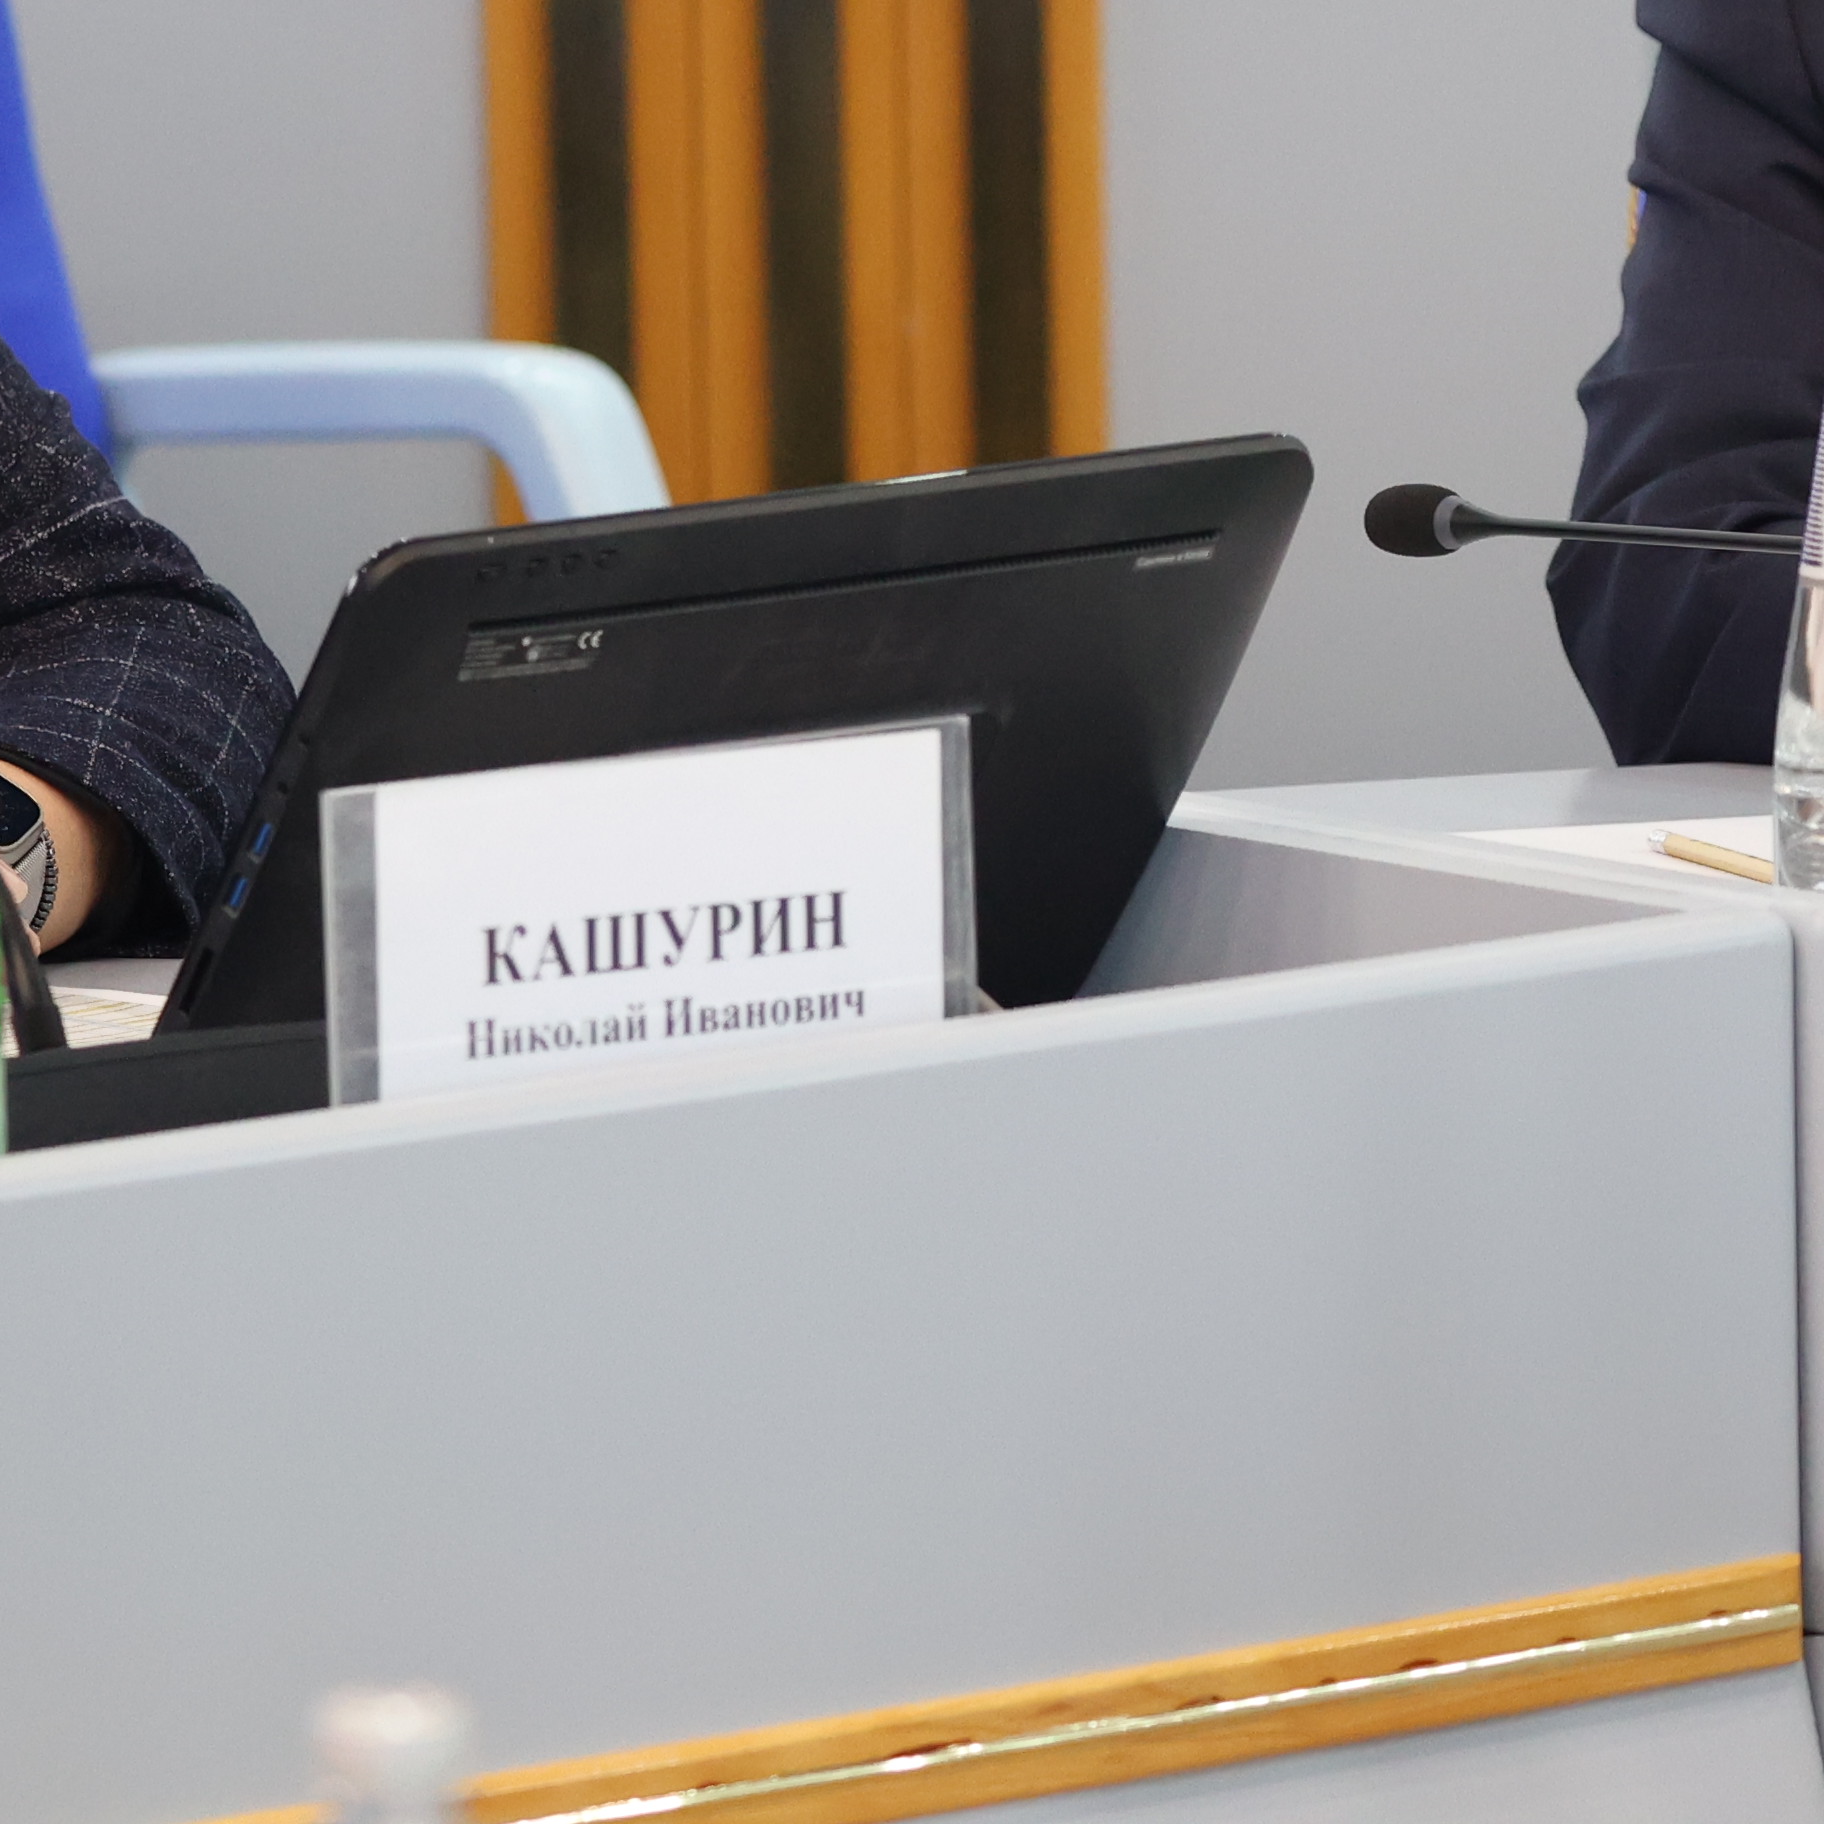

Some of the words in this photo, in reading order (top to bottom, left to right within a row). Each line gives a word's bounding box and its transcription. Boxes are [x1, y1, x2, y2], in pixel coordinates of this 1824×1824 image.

[482, 890, 846, 986] КАШУРИН
[466, 1002, 647, 1059] Николай
[664, 989, 865, 1038] Иванович
